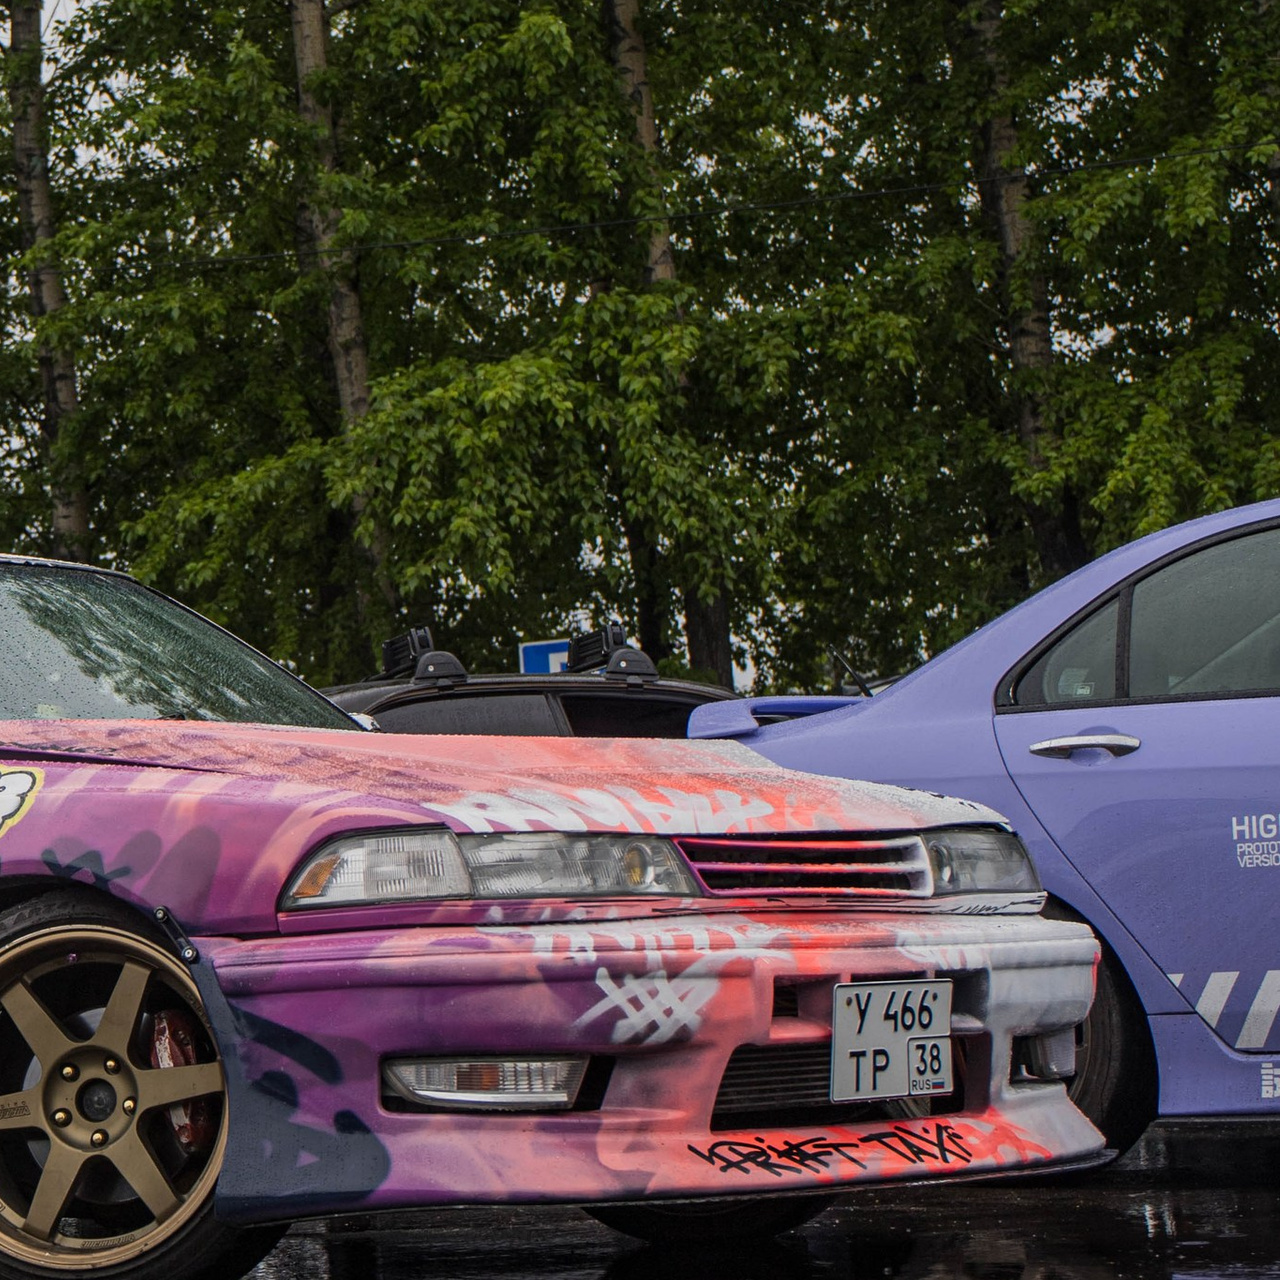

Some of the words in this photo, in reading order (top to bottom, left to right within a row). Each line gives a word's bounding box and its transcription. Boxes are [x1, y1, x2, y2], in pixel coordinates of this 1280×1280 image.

[1231, 814, 1280, 840] HIG
[883, 990, 933, 1033] 466
[915, 1042, 942, 1076] 38
[911, 1079, 932, 1091] RUS
